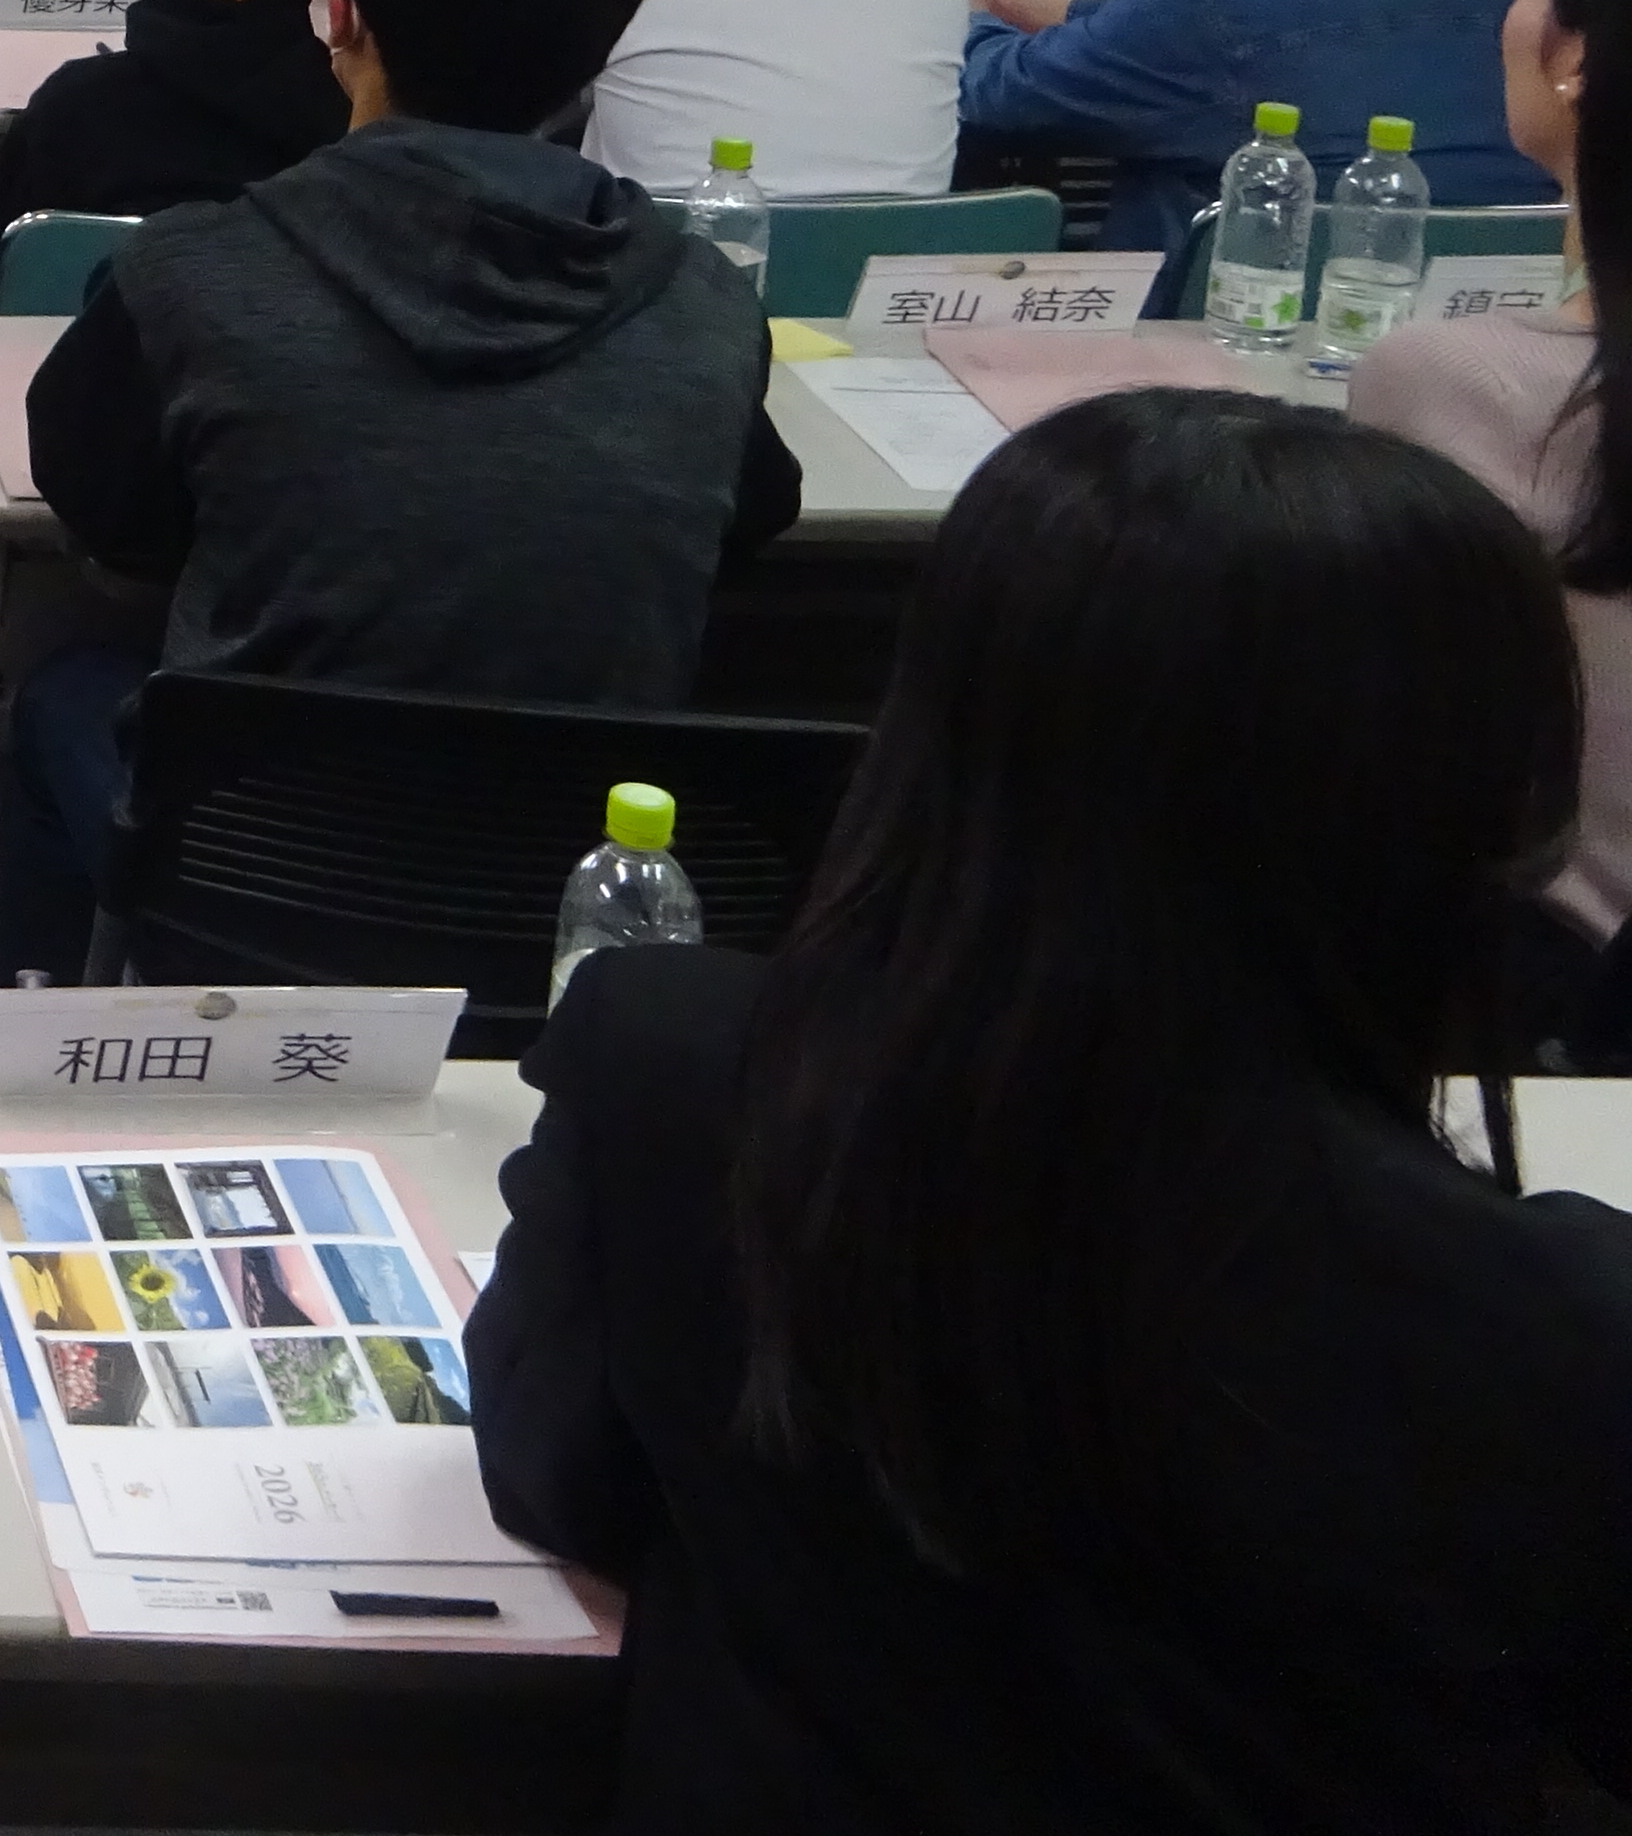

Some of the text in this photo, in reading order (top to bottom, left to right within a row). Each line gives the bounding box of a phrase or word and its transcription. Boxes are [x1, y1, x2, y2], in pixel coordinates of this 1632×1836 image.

[881, 285, 1117, 325] 室山 結奈
[53, 1032, 353, 1084] 和田 葵
[252, 1464, 305, 1525] 2026
